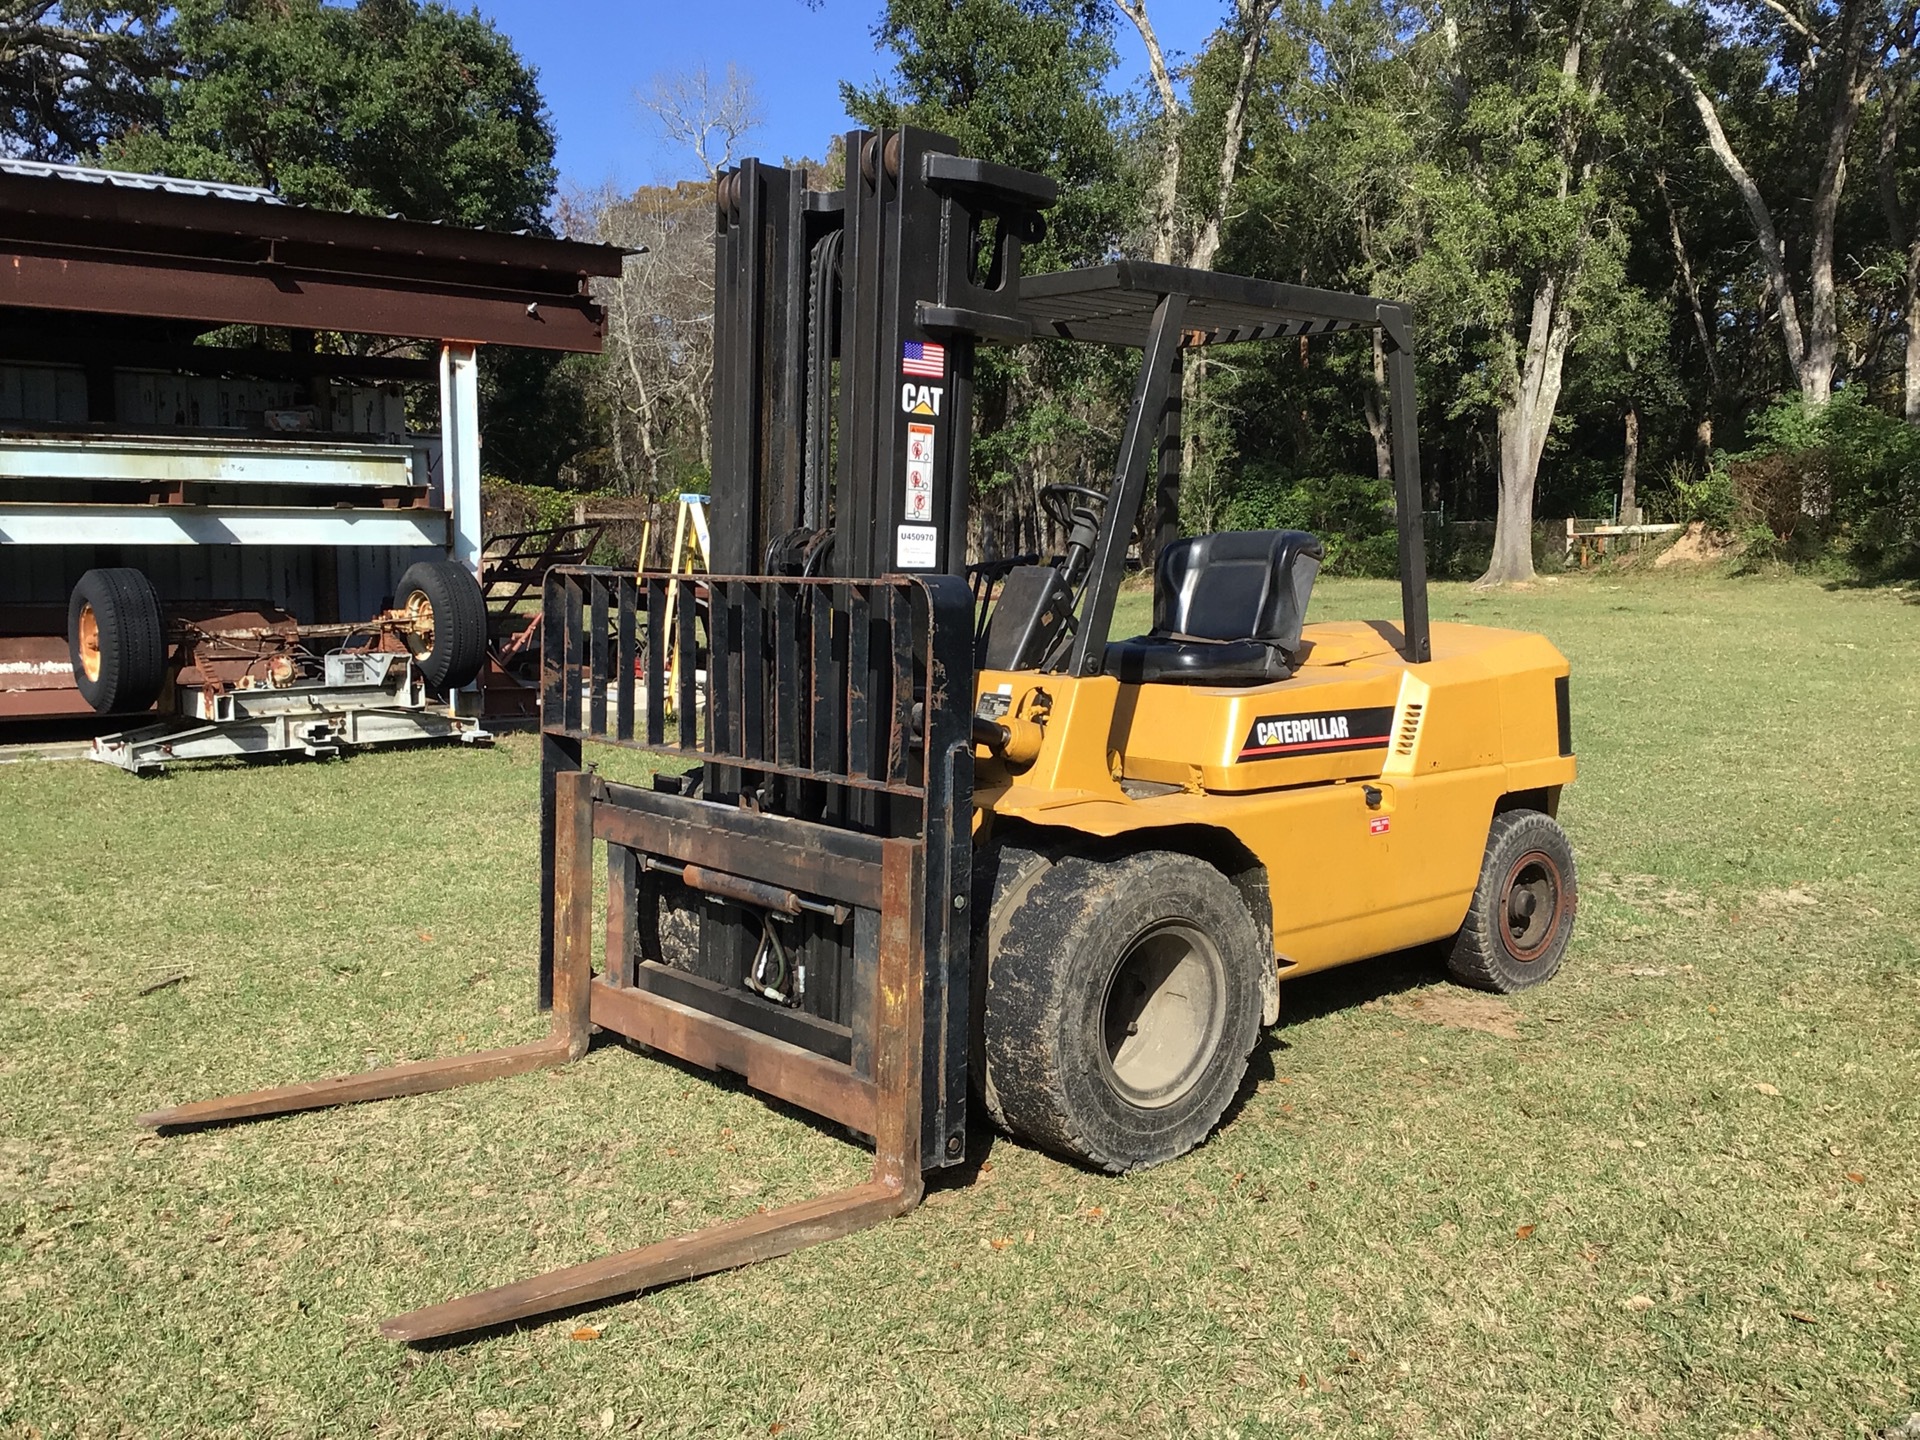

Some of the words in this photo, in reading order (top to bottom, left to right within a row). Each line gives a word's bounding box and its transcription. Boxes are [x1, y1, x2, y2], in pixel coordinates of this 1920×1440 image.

[902, 383, 943, 416] CAT
[901, 533, 933, 541] U450970
[1257, 716, 1349, 745] CATERPILLAR
